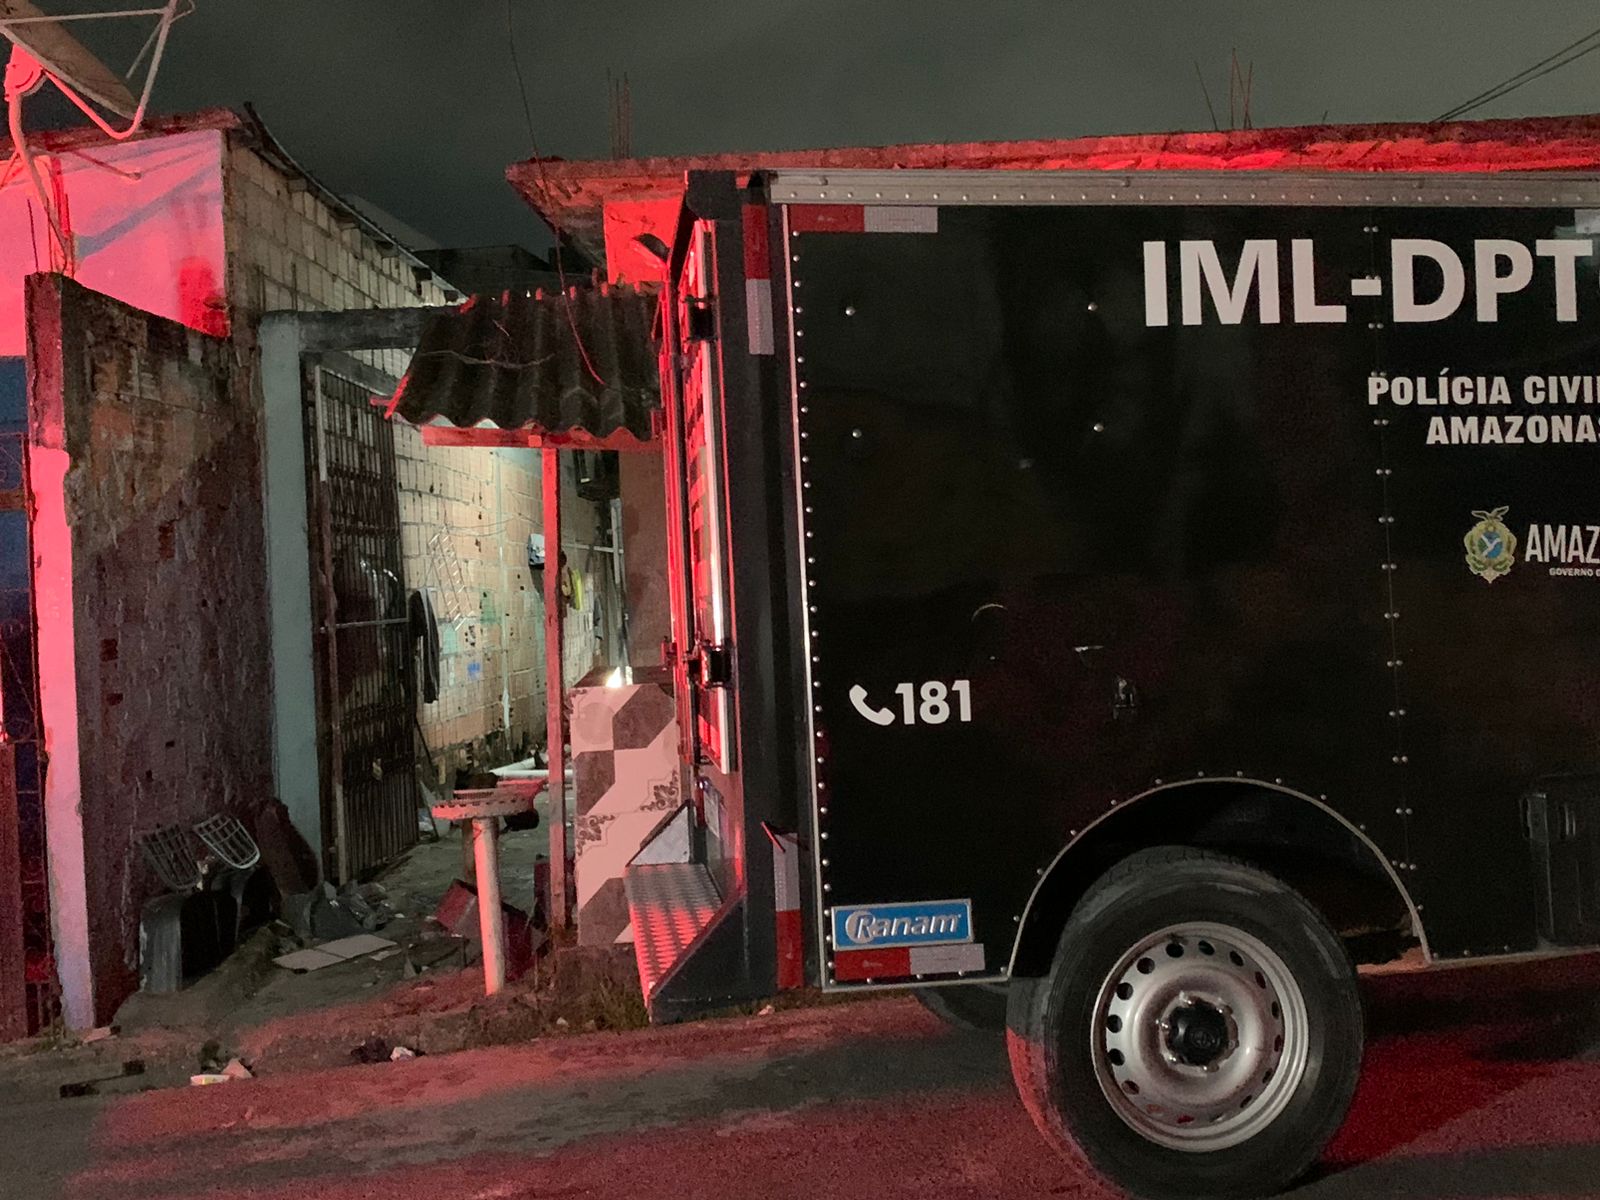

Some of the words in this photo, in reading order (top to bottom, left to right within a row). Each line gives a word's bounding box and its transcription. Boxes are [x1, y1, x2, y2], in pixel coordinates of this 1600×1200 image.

[1143, 238, 1600, 326] IML-DPT
[1367, 367, 1512, 405] POLÍCIA
[1523, 375, 1600, 405] CIVI
[1426, 415, 1600, 444] AMAZONA
[1549, 567, 1594, 577] GOVERNO
[895, 679, 972, 725] 181
[853, 912, 961, 939] Ranam
